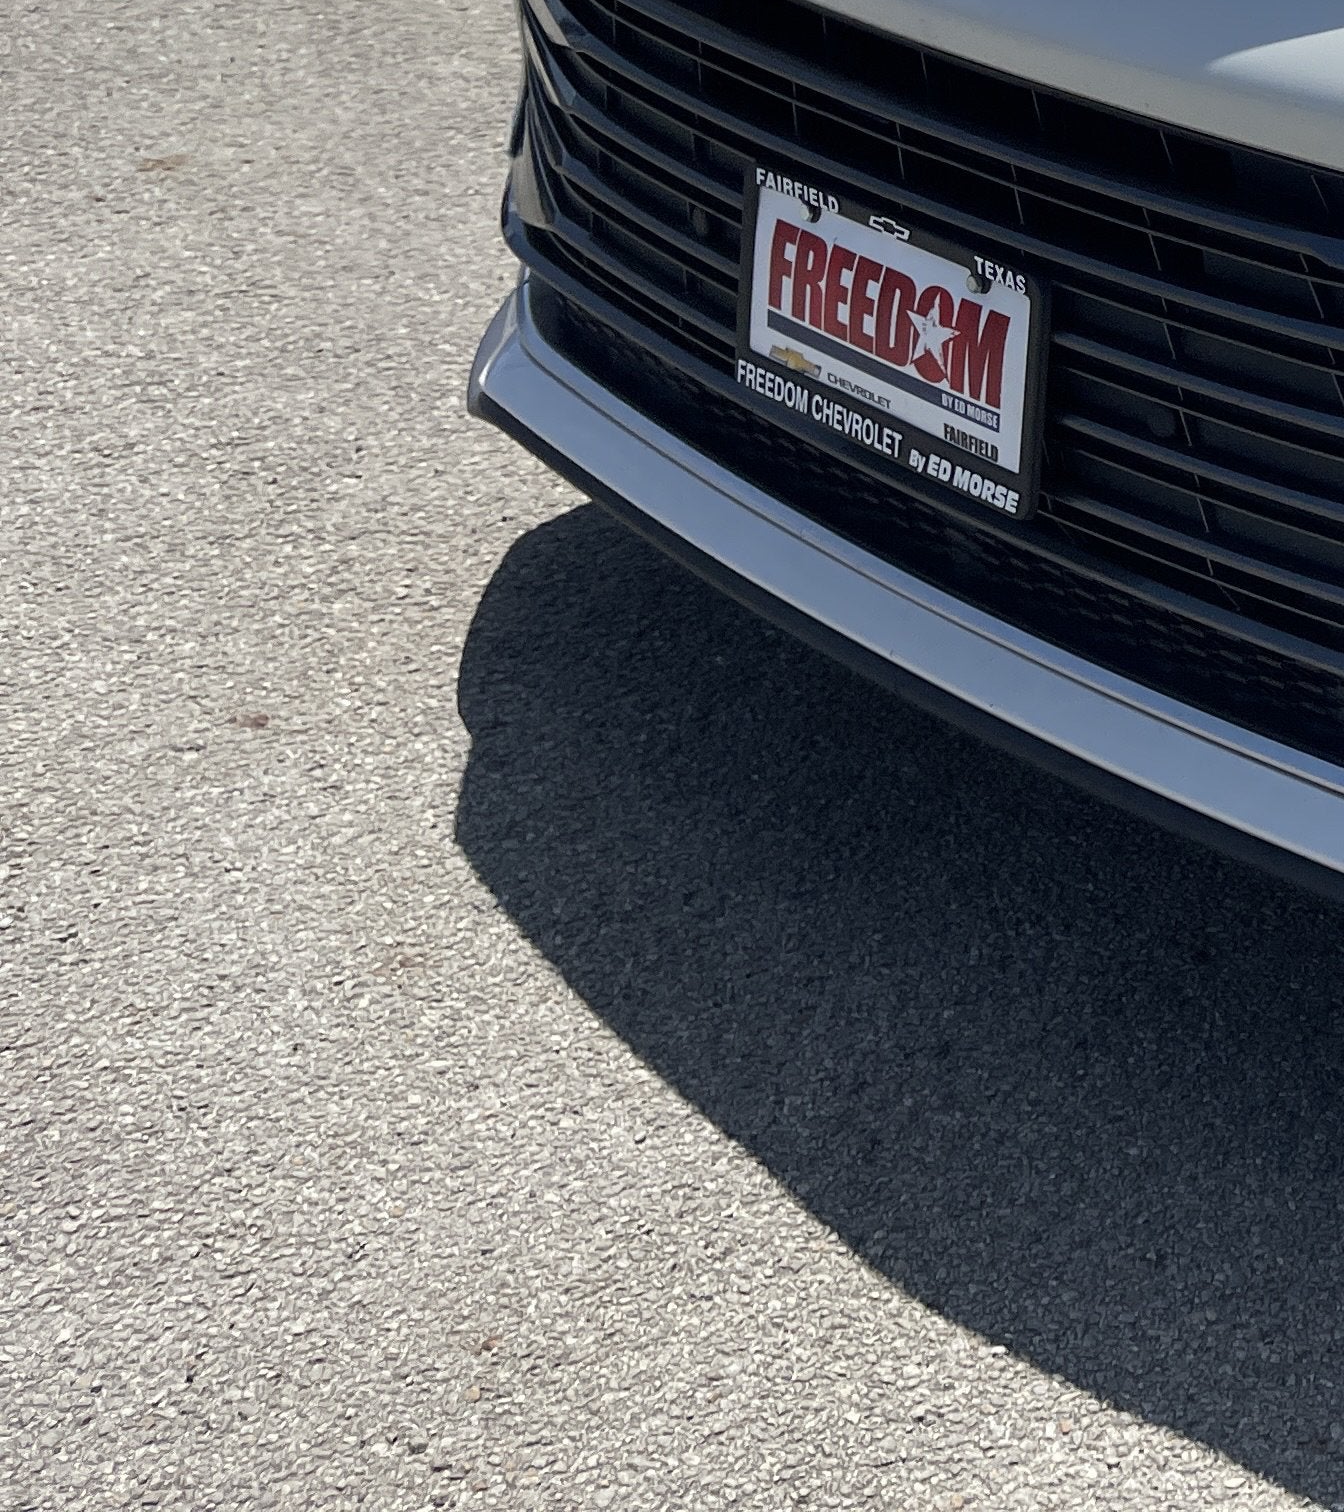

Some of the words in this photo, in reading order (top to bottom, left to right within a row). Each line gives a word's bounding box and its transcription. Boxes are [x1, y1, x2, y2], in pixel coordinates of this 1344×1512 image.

[756, 168, 839, 213] FAIRFIELD
[974, 256, 1026, 294] TEXAS
[768, 218, 1011, 409] FREEDOM
[827, 372, 892, 409] CHEVROLET
[941, 393, 953, 408] BY
[954, 397, 966, 414] ED
[967, 403, 999, 428] MORSE
[737, 359, 809, 414] FREEDOM
[811, 394, 903, 458] CHEVROLET
[926, 453, 952, 482] ED
[953, 466, 1020, 514] MORSE
[944, 423, 998, 463] FAIRFIELD
